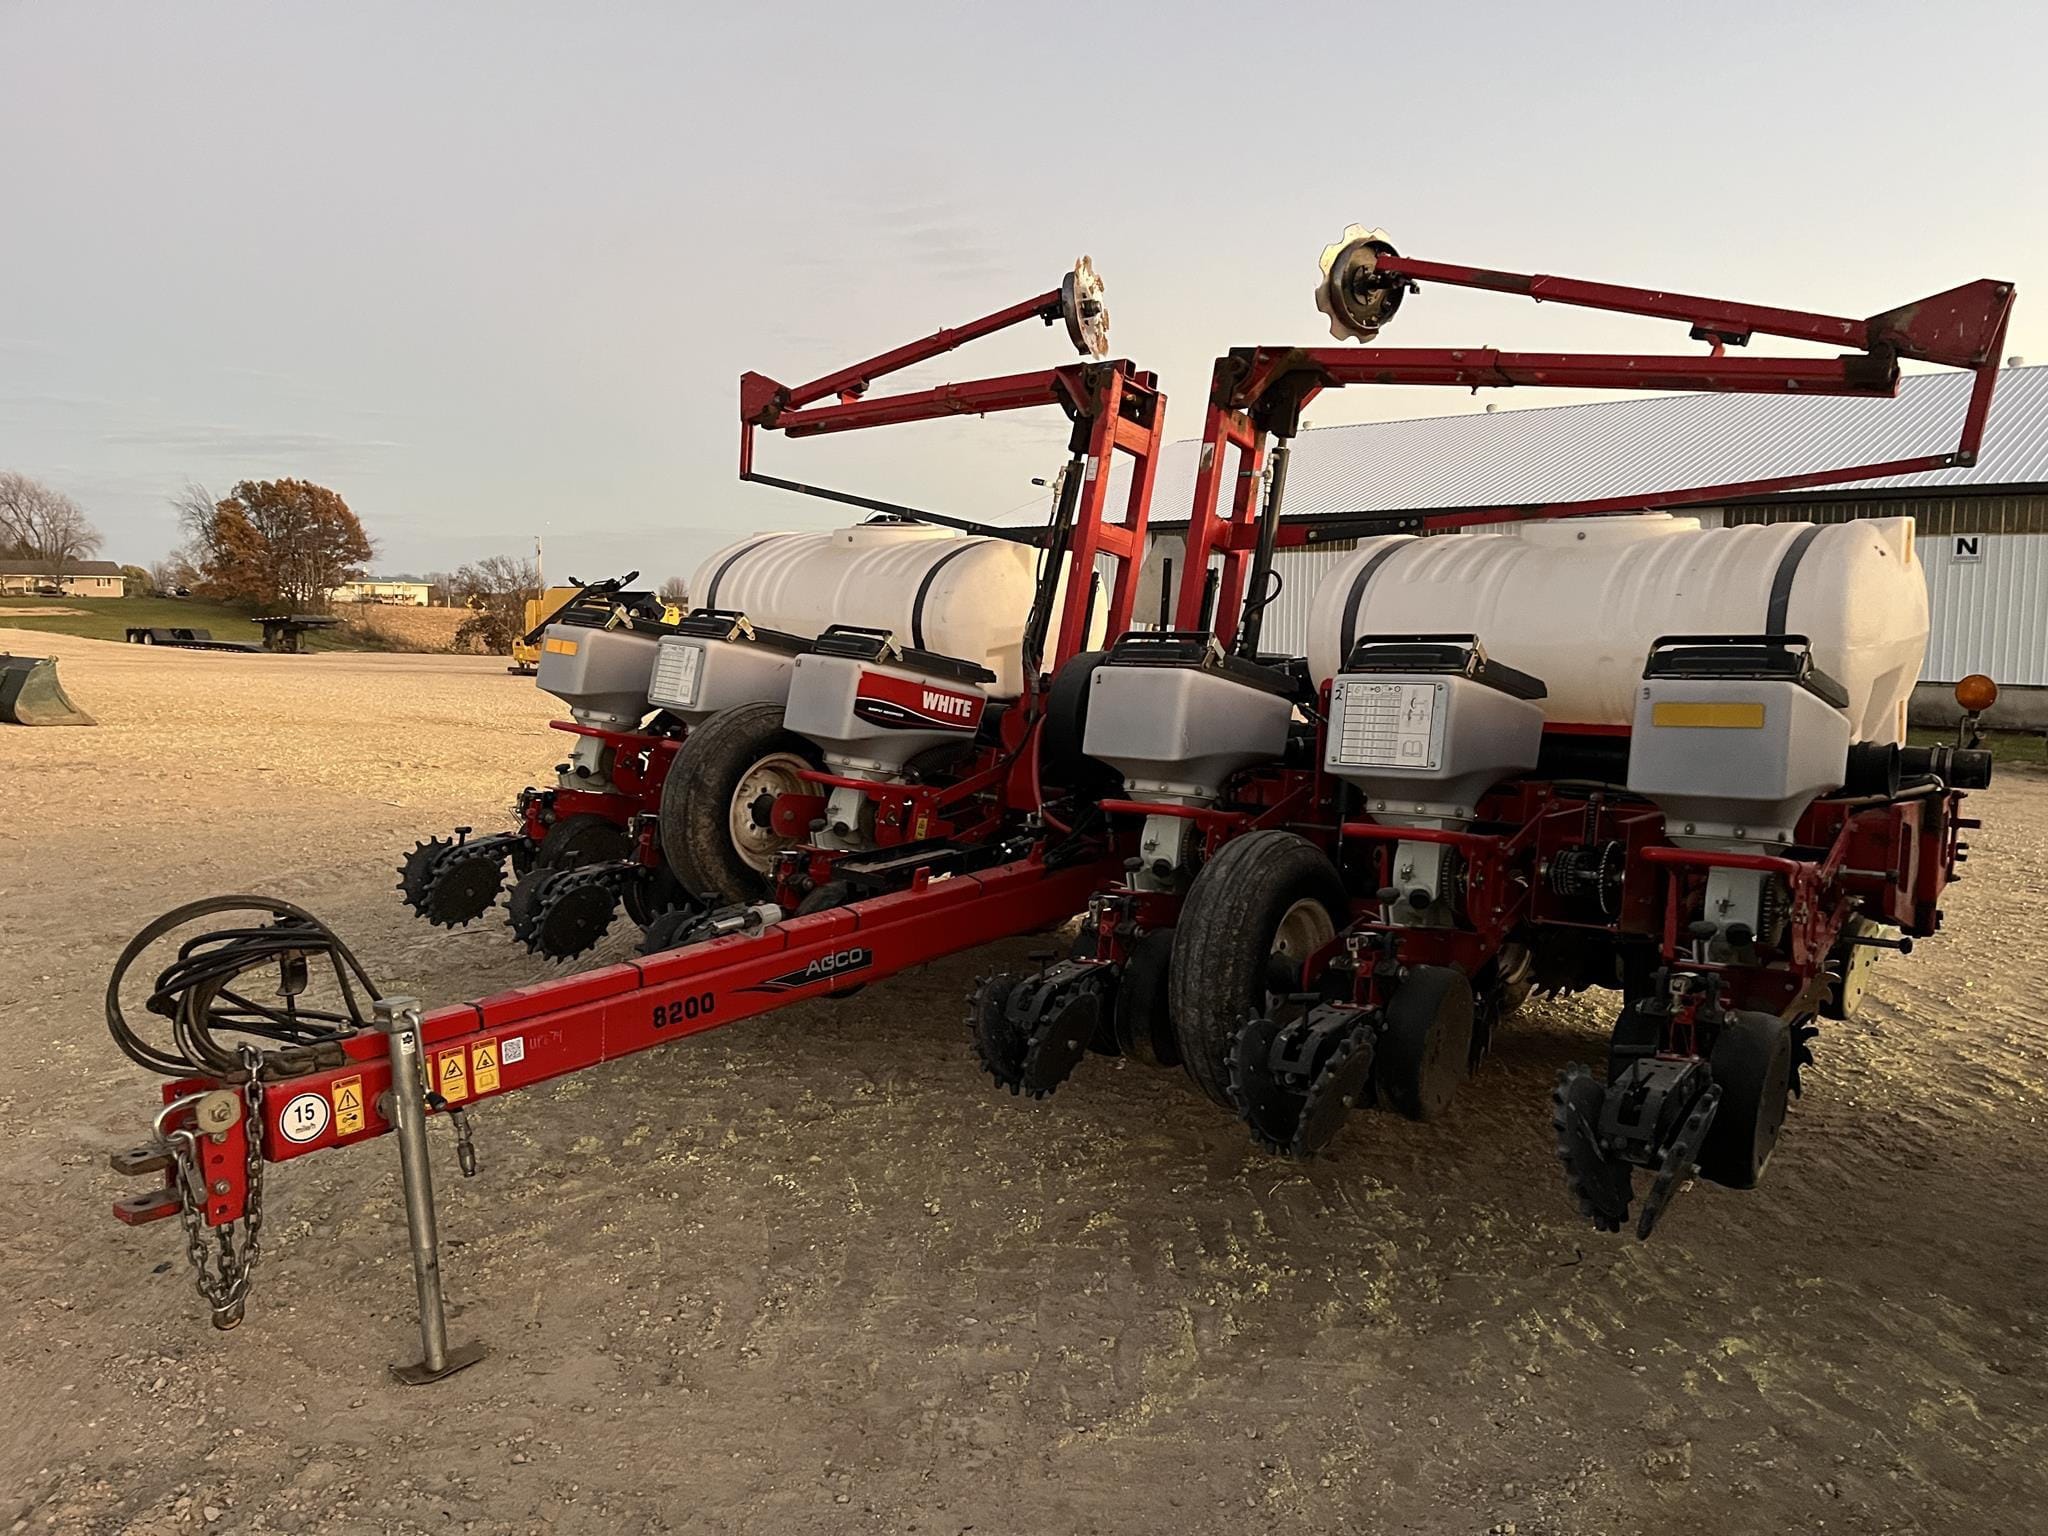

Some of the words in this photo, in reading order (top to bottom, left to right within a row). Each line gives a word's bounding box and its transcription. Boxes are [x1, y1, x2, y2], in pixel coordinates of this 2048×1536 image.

[1957, 538, 1978, 554] N
[922, 690, 972, 717] WHITE
[1335, 690, 1342, 700] 2
[806, 948, 863, 976] AGCO
[653, 992, 715, 1028] 8200
[294, 1103, 315, 1123] 15
